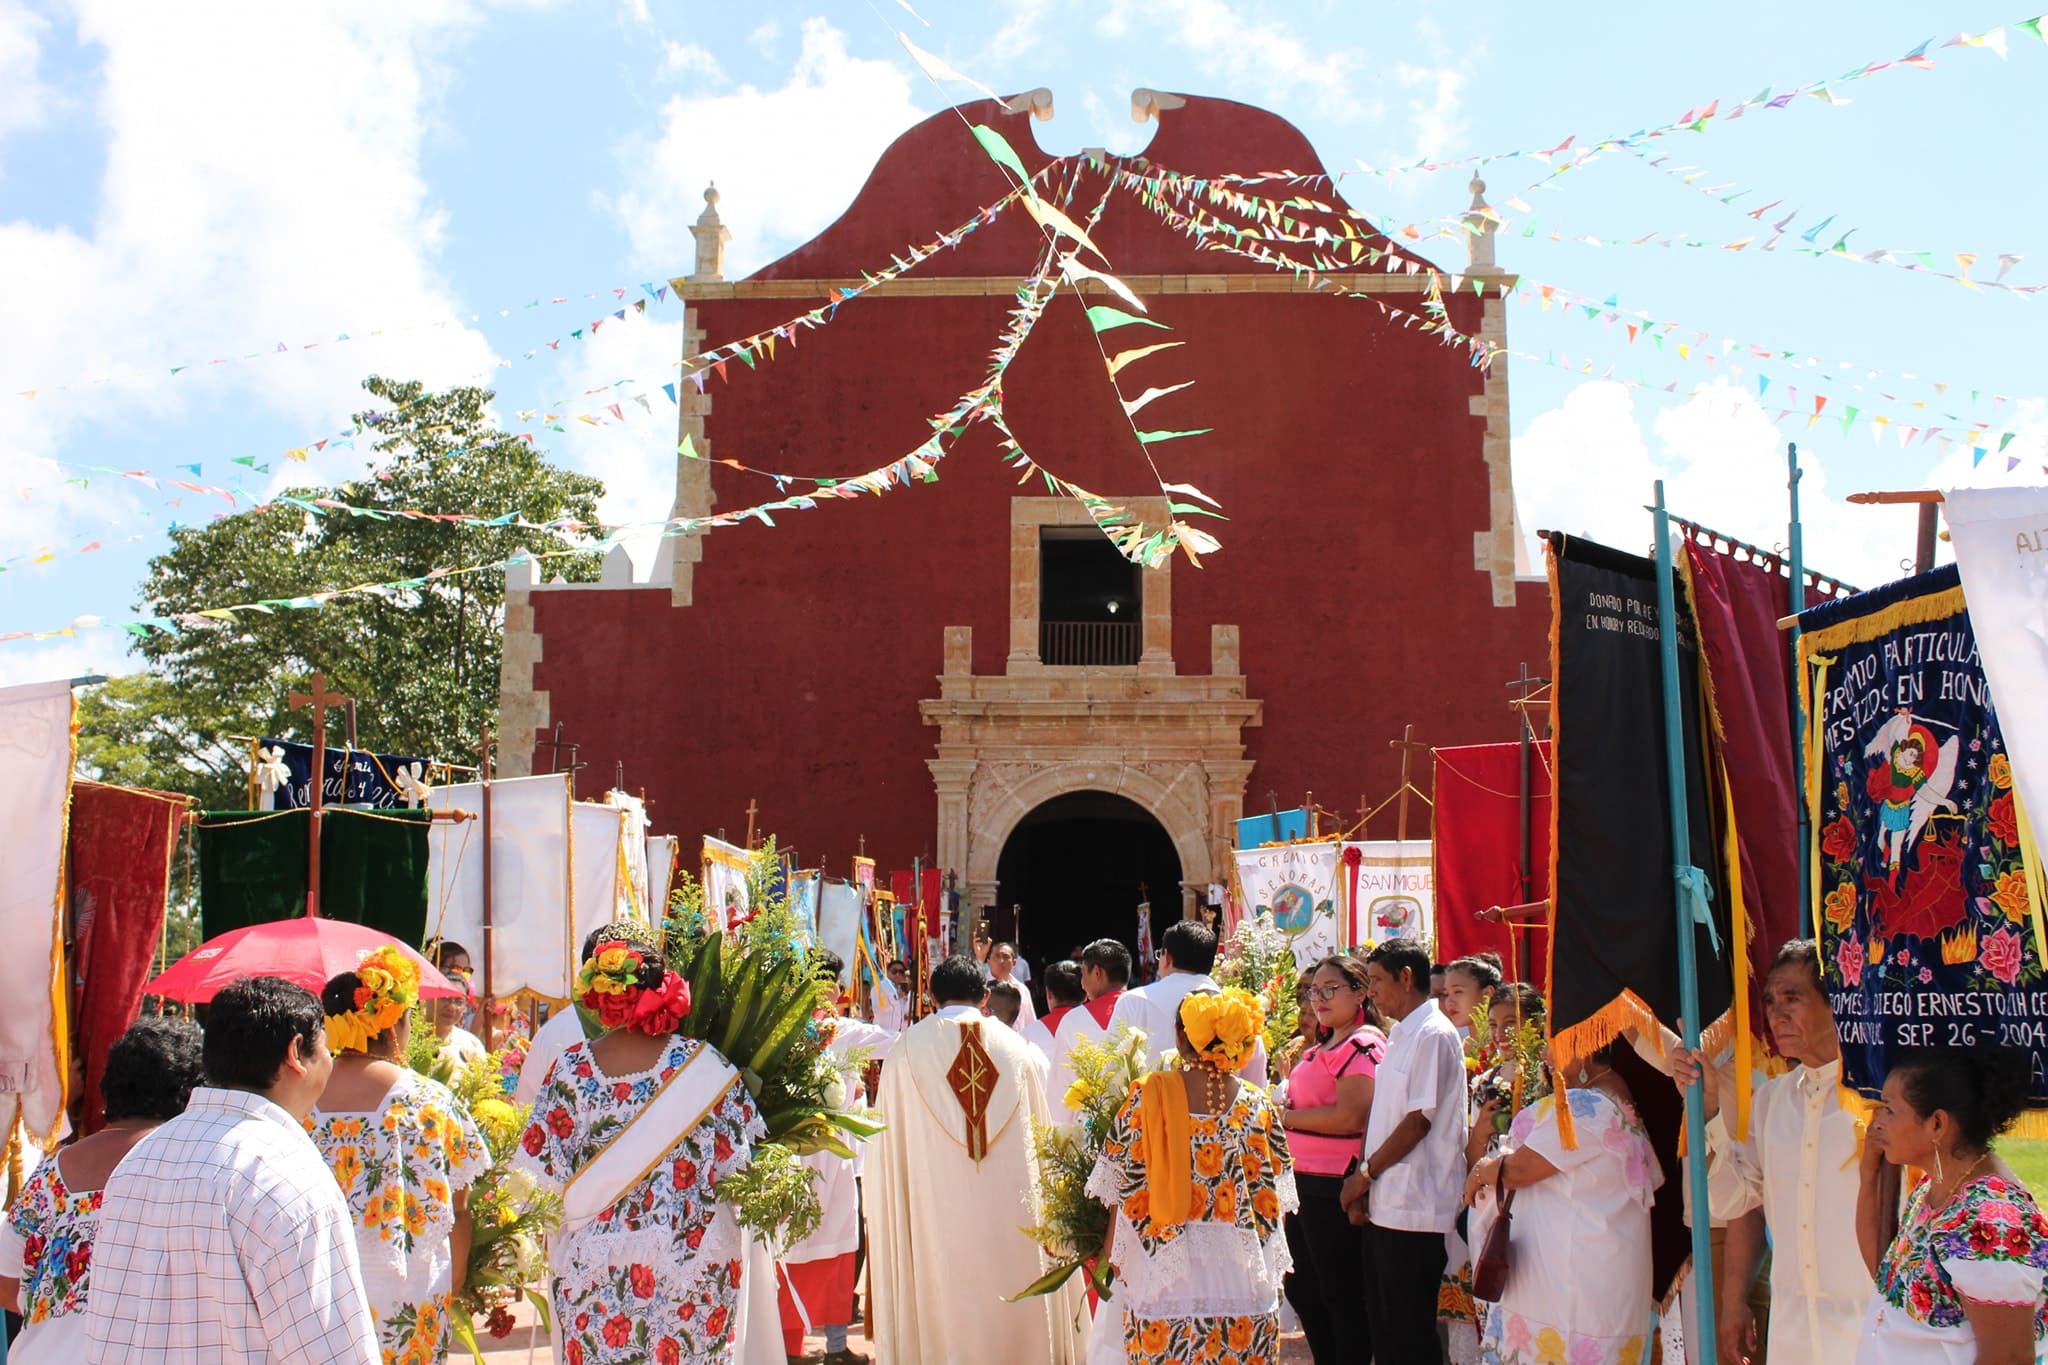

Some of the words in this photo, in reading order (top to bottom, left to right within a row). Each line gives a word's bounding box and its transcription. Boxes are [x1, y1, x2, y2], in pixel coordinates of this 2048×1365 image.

[1586, 614, 1599, 630] EN
[1823, 683, 1889, 753] MESIZOS
[1897, 671, 1924, 705] EN
[1939, 670, 1993, 714] HONO
[1258, 850, 1319, 868] GREMIO
[1361, 873, 1391, 890] SAN
[1918, 992, 2006, 1017] ERNESTO
[1897, 1023, 1935, 1047] SEP.
